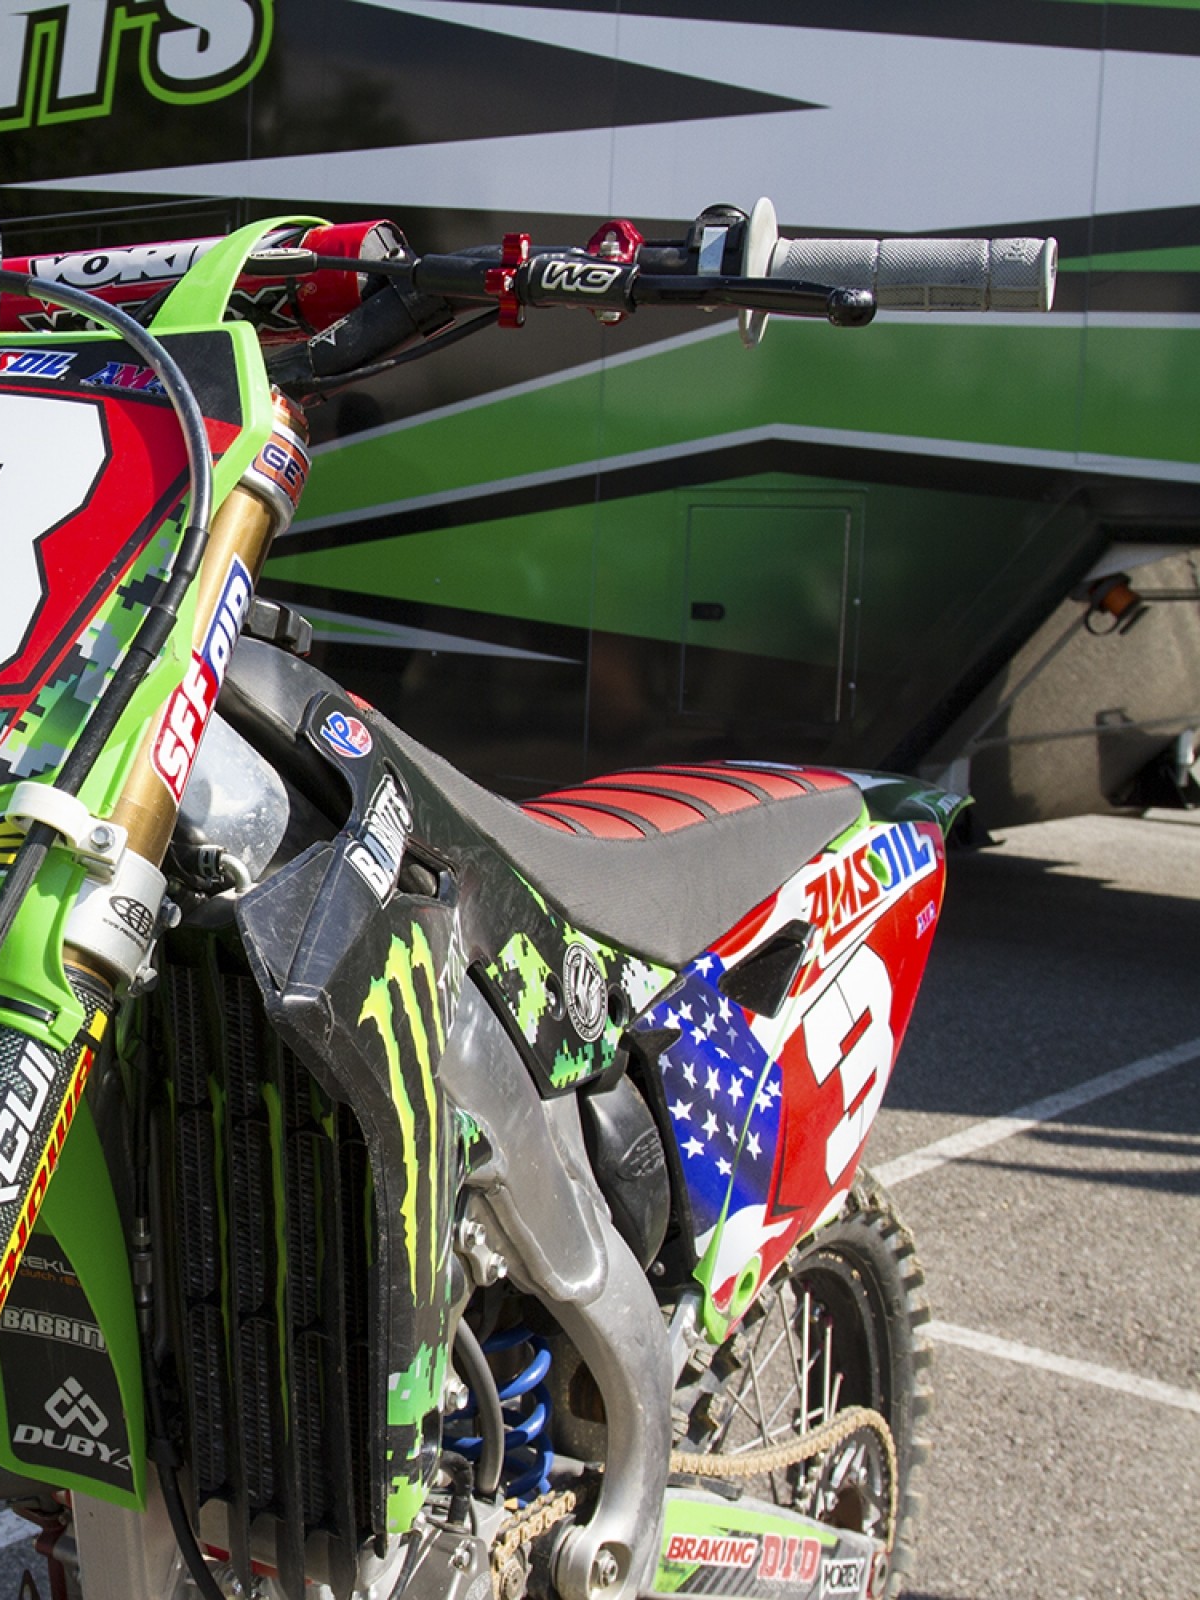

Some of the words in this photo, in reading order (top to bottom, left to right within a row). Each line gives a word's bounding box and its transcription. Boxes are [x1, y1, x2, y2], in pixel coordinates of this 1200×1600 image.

[158, 652, 216, 796] SFF
[803, 820, 933, 957] AMSOIL
[802, 941, 893, 1187] 3
[3, 1307, 108, 1350] BABBITT
[666, 1535, 756, 1564] BRAKING
